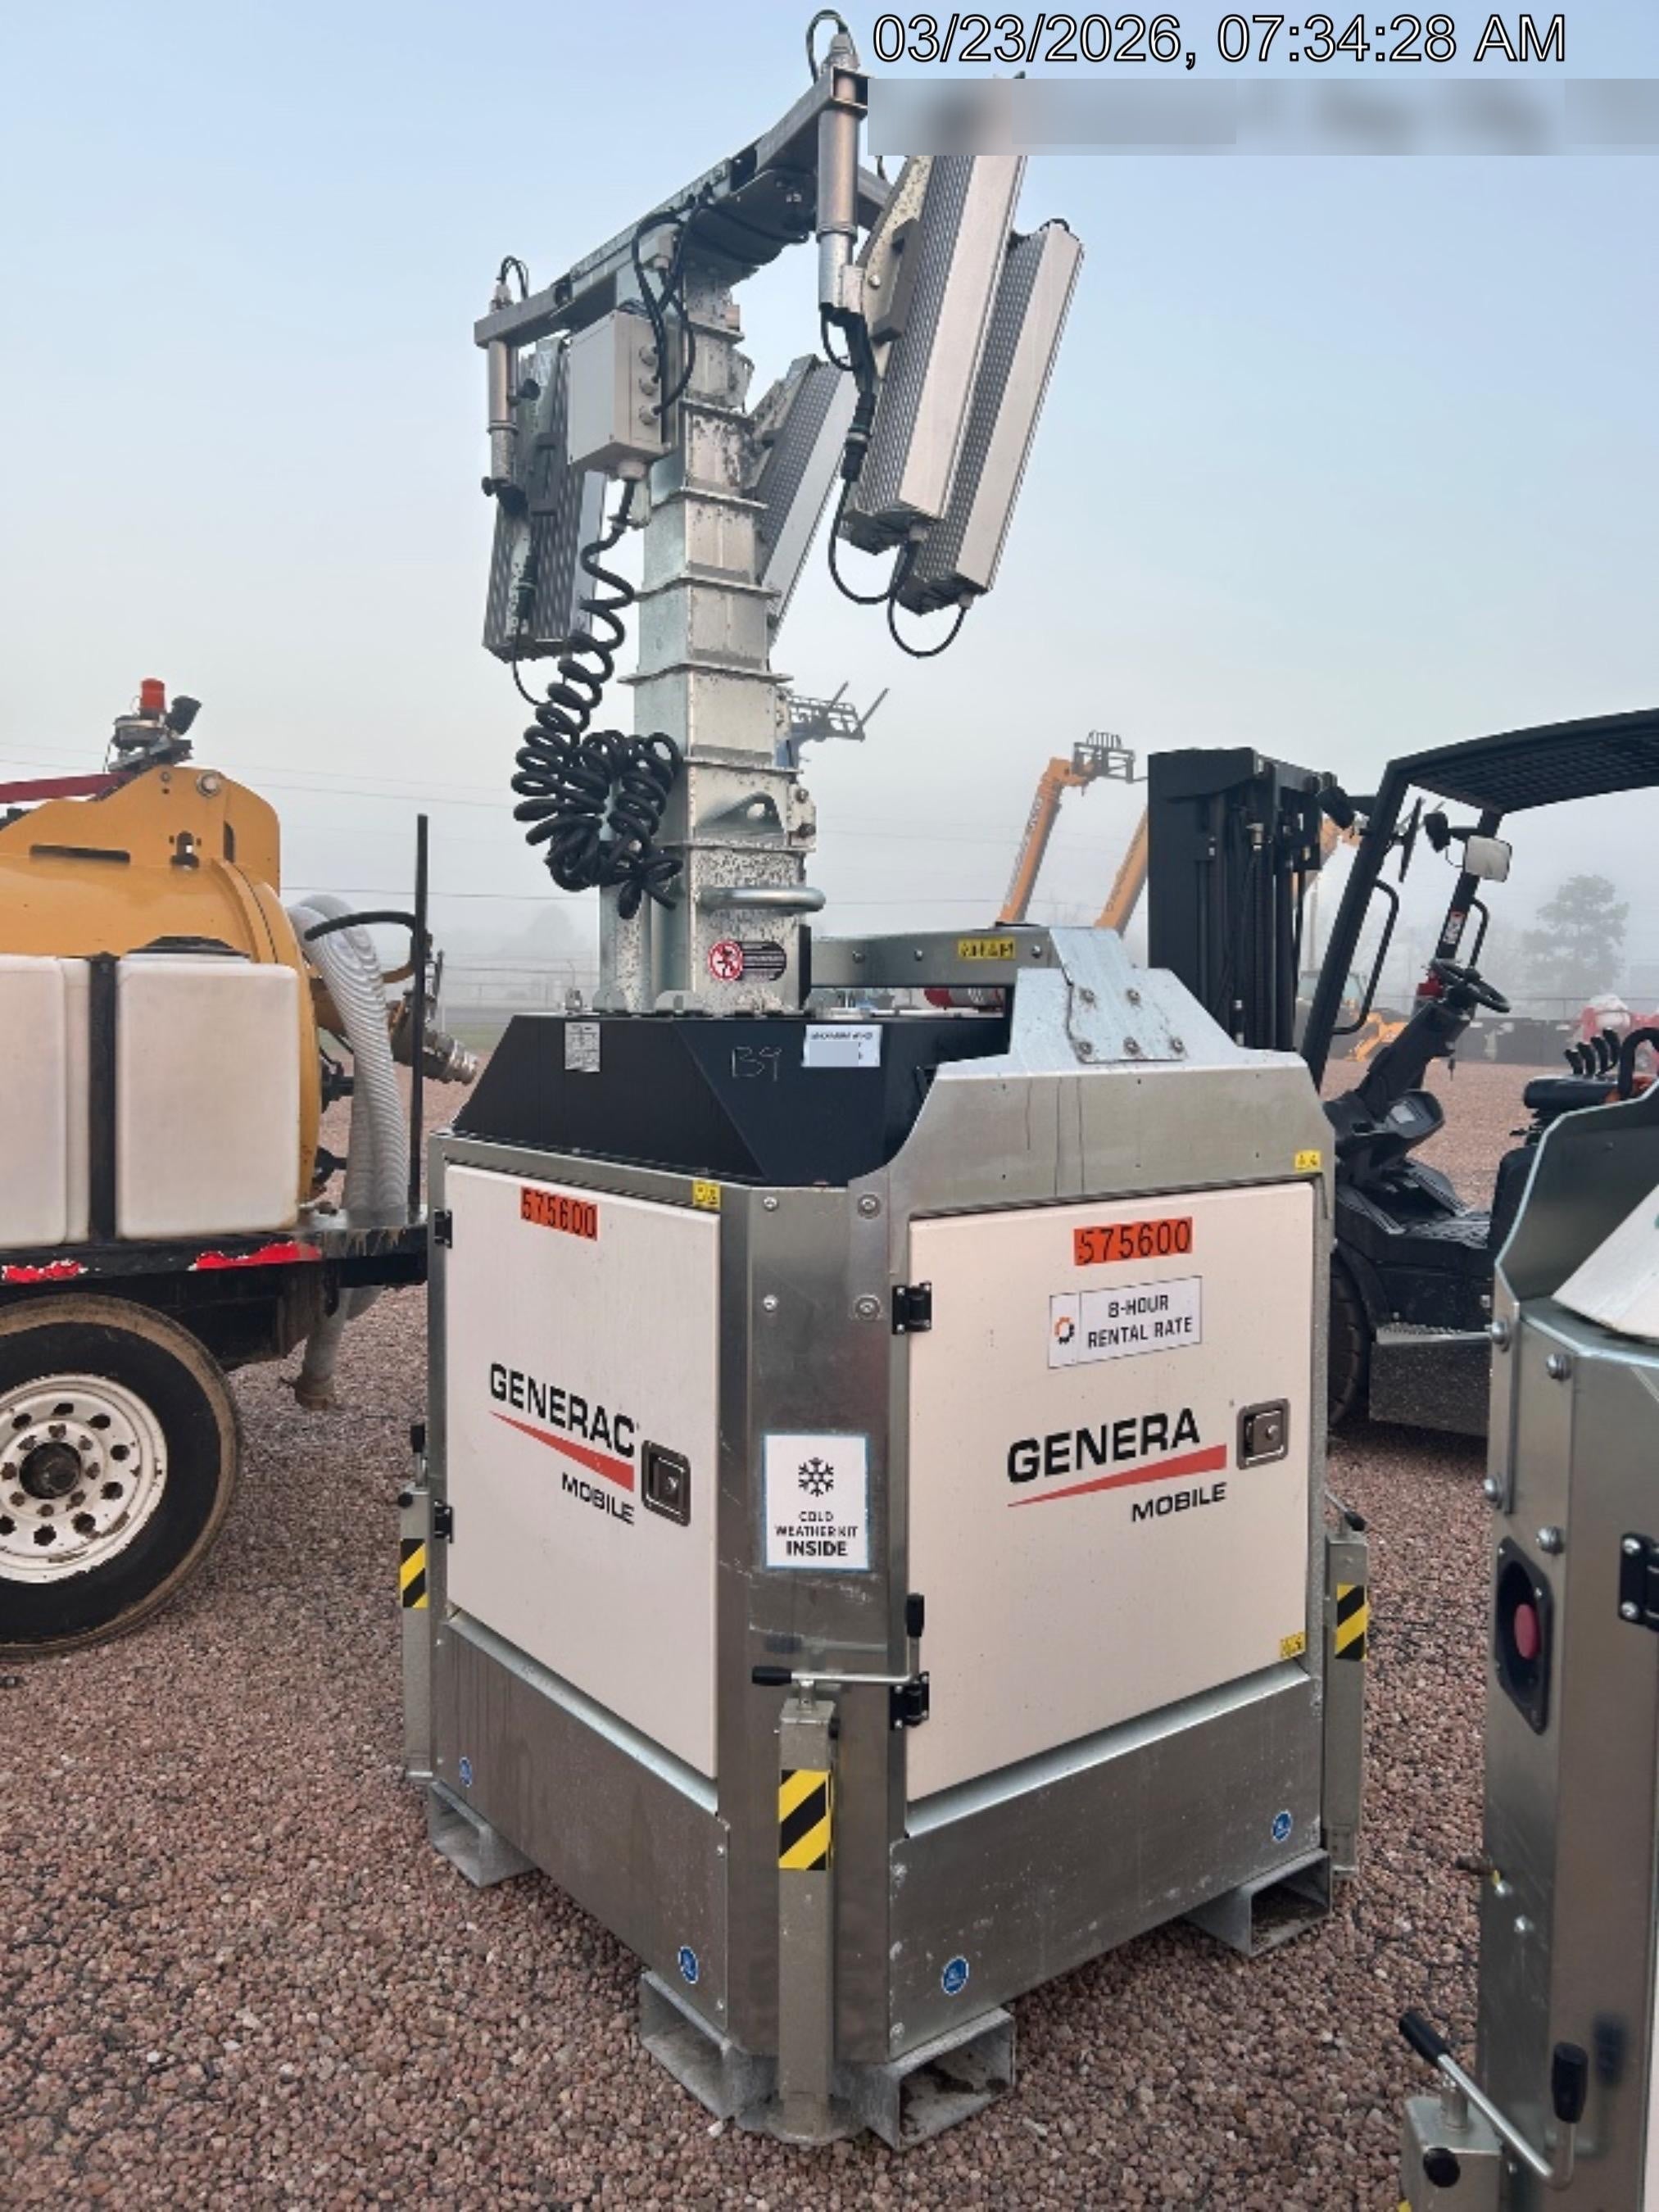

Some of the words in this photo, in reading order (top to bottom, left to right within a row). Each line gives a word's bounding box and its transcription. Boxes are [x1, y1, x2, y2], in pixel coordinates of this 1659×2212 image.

[522, 1188, 596, 1238] 575600
[1077, 1220, 1189, 1265] 575600
[1108, 1294, 1169, 1318] 8-HOUR
[1087, 1324, 1149, 1349] RENTAL
[1154, 1317, 1193, 1338] RATE
[491, 1362, 635, 1458] GENERAC
[1008, 1407, 1200, 1483] GENERA
[562, 1471, 634, 1526] MOBILE
[799, 1511, 834, 1522] COLD
[1131, 1481, 1227, 1522] MOBILE
[775, 1525, 836, 1537] WEATHER
[837, 1525, 859, 1538] KIT
[786, 1540, 848, 1557] INSIDE
